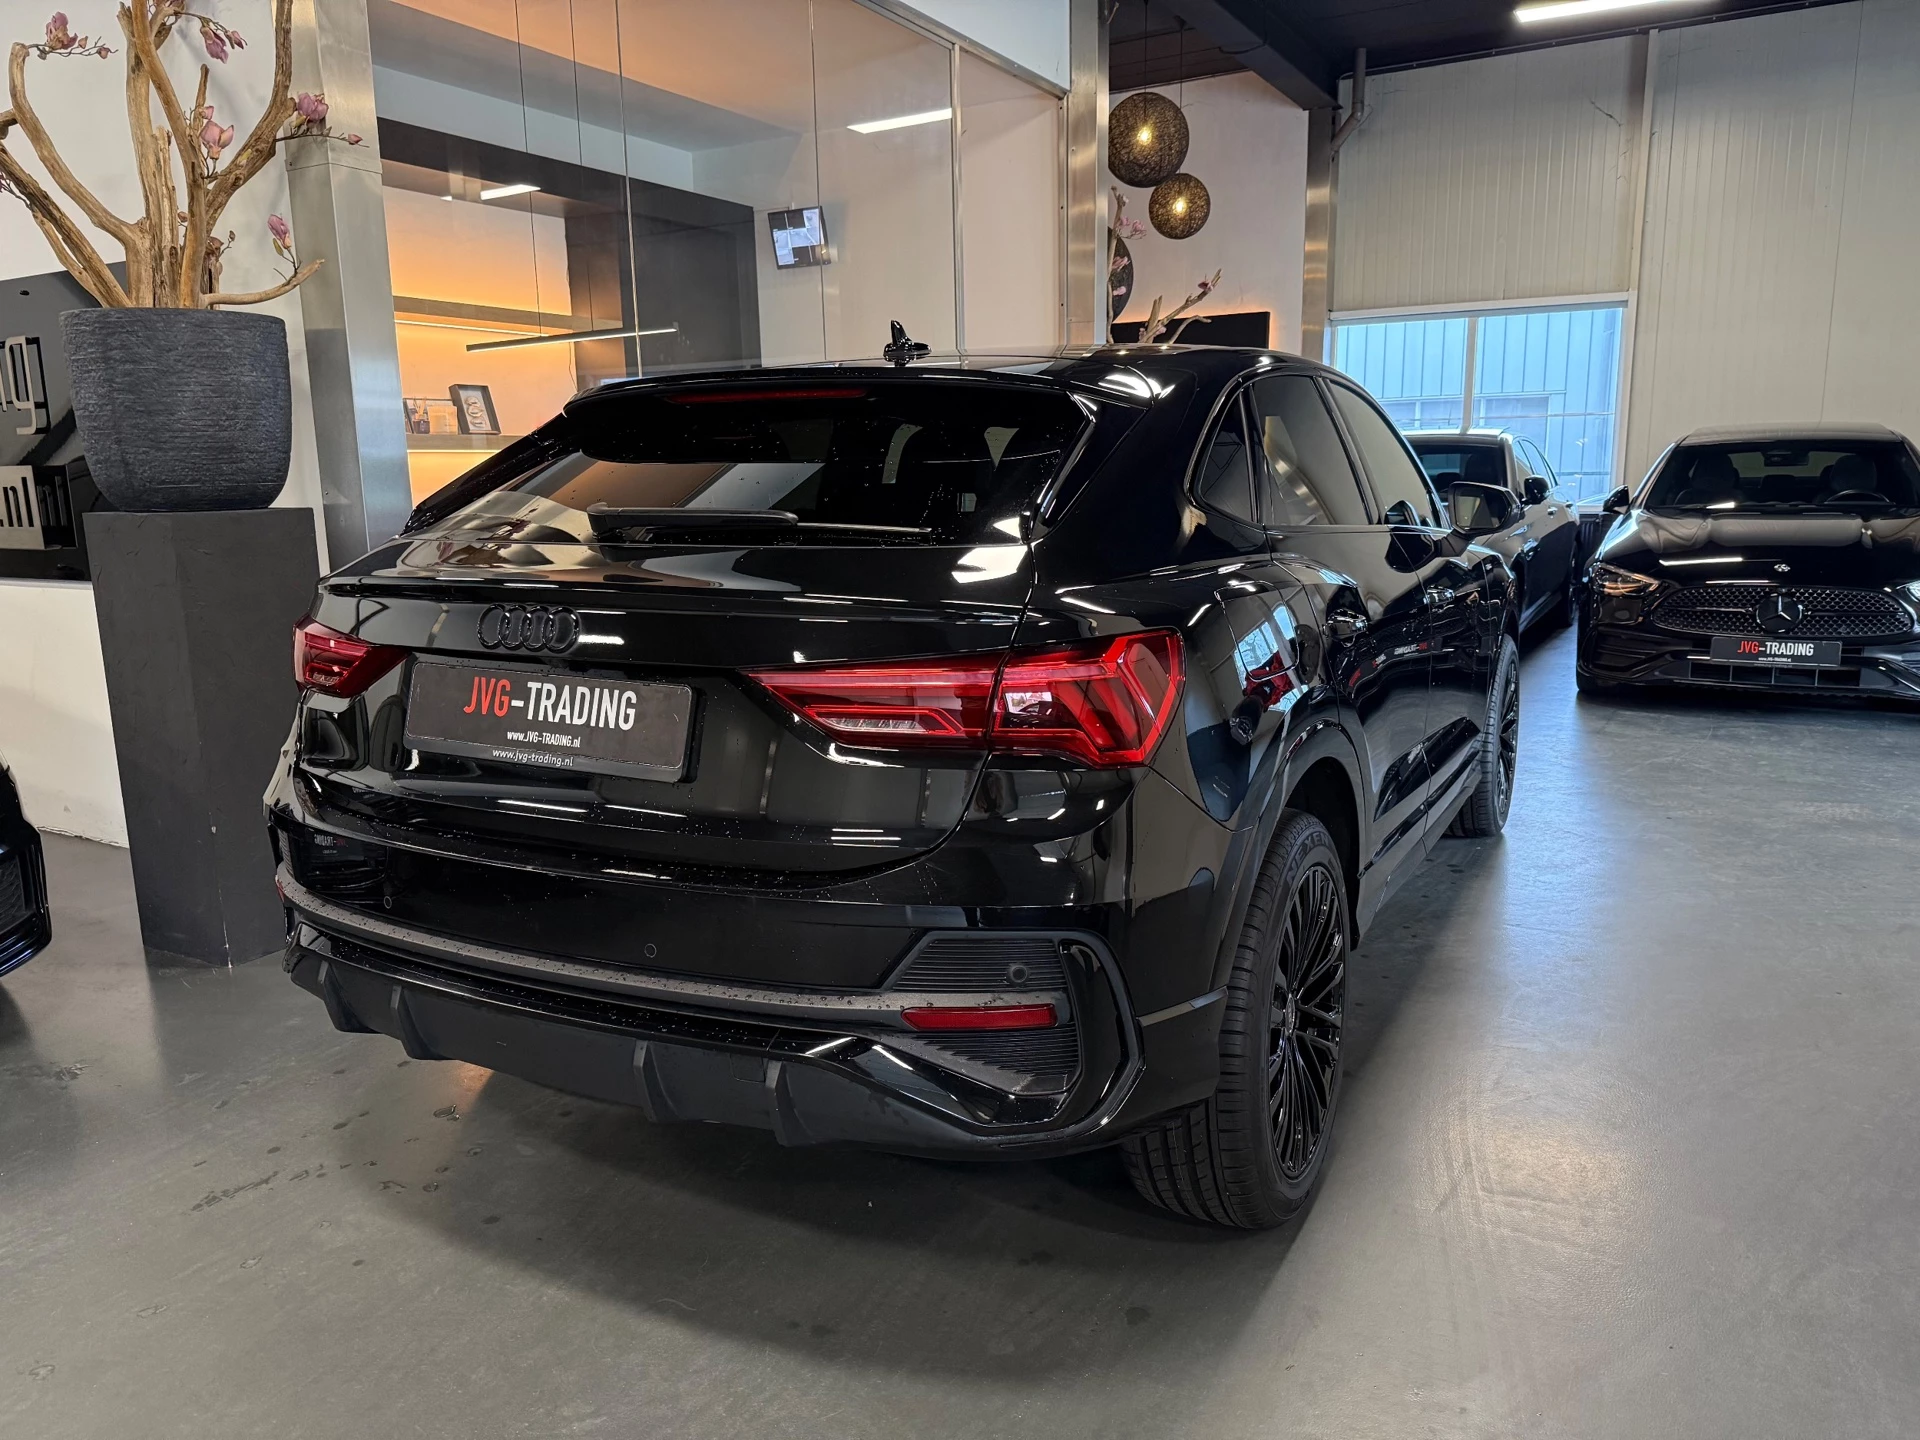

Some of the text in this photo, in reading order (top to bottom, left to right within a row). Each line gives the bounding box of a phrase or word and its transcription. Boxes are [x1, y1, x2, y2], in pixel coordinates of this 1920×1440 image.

[1738, 641, 1814, 656] JVG-TRADING
[463, 676, 637, 730] JVG-TRADING
[507, 731, 581, 748] www.JVG-TRADING.nl
[492, 749, 574, 767] www.jvg-trading.nl
